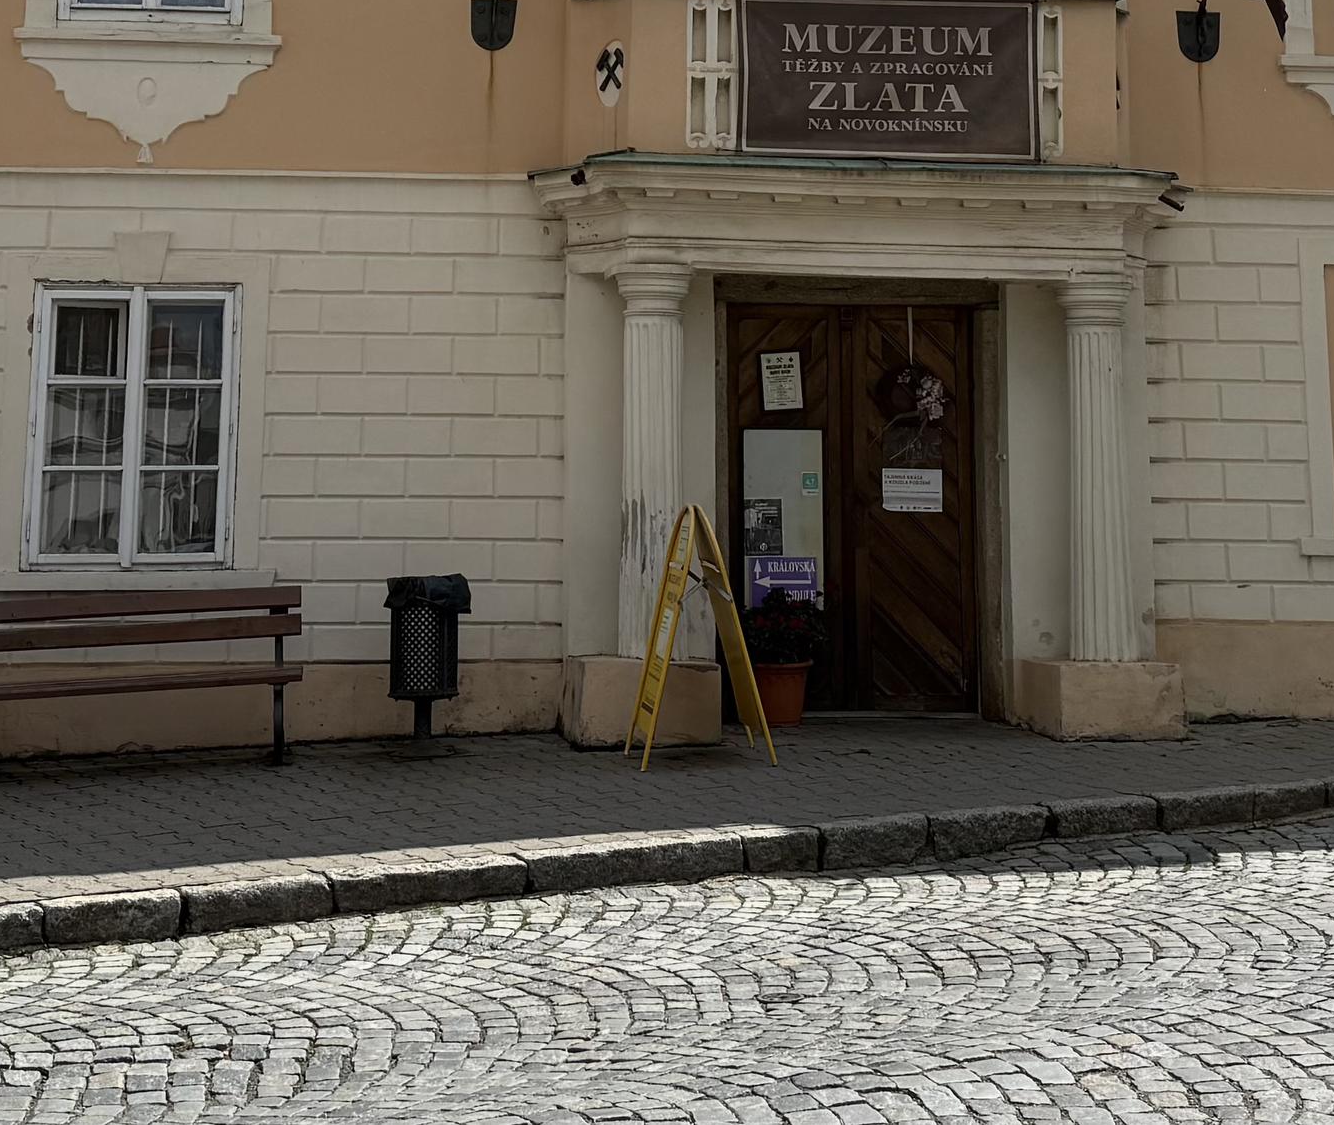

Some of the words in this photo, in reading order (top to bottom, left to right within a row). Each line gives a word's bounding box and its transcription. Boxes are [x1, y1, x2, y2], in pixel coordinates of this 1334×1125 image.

[781, 23, 992, 56] MUZEUM
[782, 57, 845, 74] TĚŽBY
[852, 62, 864, 74] A
[870, 60, 995, 76] ZPRACOVÁNÍ
[807, 81, 969, 114] ZLATA
[807, 118, 833, 131] NA
[839, 116, 969, 133] NOVOKNÍNSKU
[768, 559, 816, 573] KRÁLOVSKÁ
